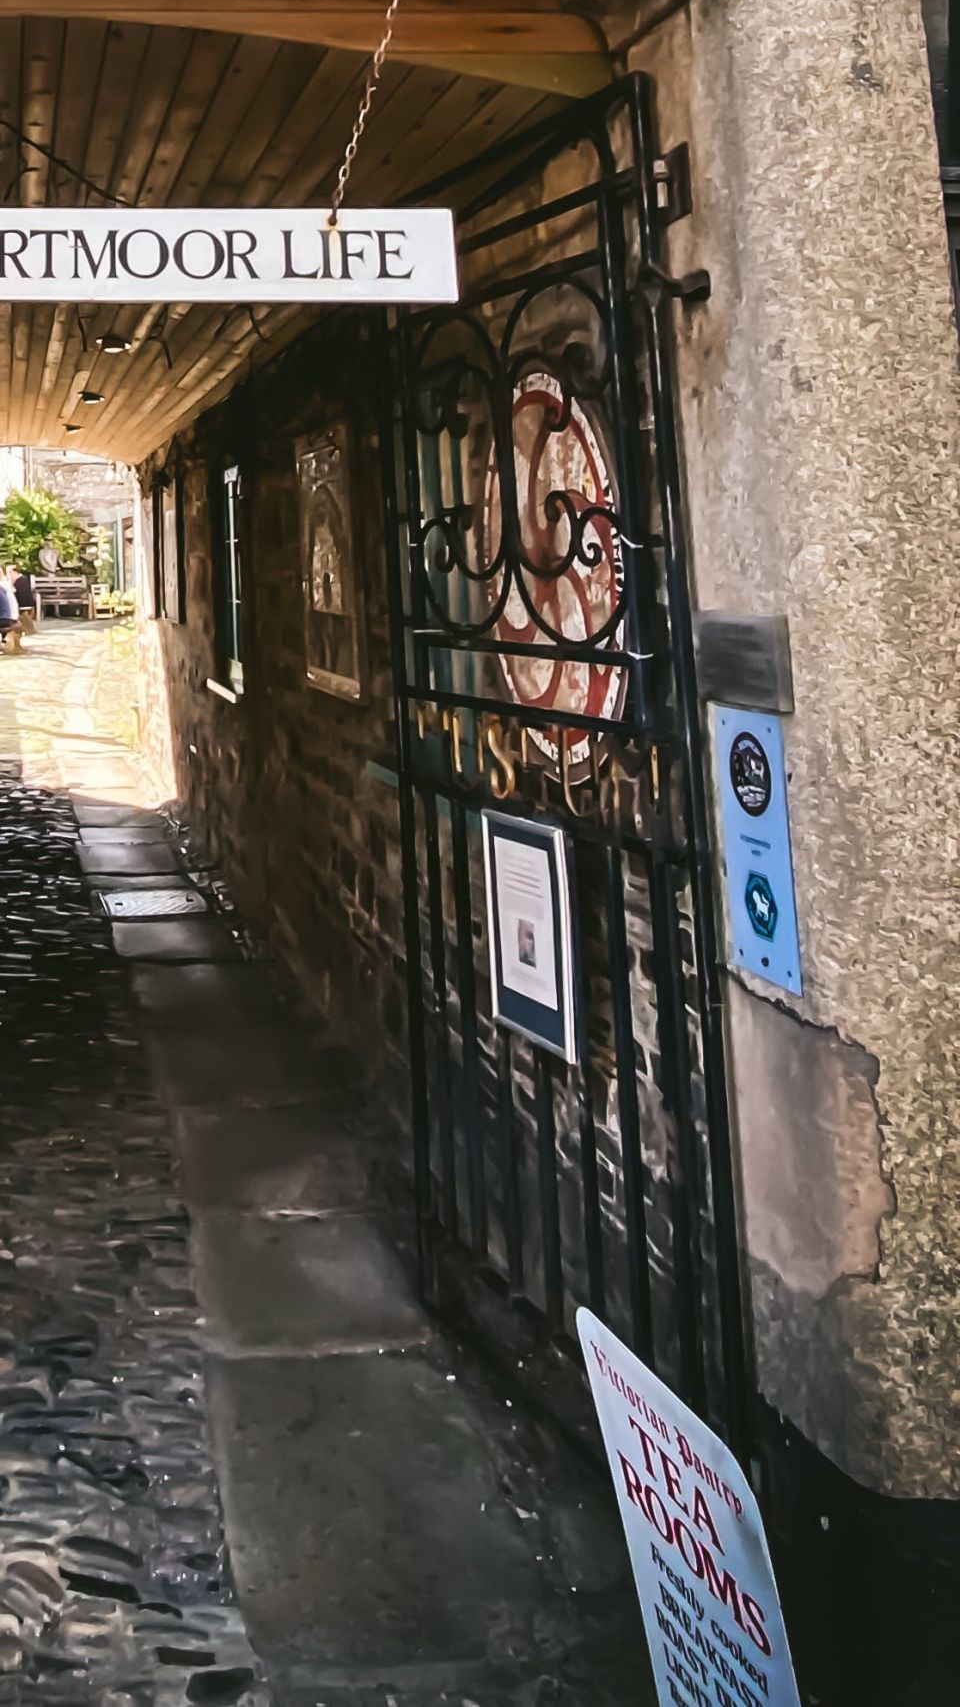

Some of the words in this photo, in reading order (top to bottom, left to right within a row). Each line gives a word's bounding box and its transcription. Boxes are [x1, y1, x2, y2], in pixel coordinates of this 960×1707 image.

[281, 227, 413, 280] LIFE
[590, 1340, 672, 1444] Victorian
[673, 1425, 744, 1523] Pantry
[627, 1414, 726, 1558] TEA
[615, 1448, 773, 1658] ROOMS
[650, 1540, 705, 1622] Freshly
[709, 1618, 769, 1698] cooked
[654, 1602, 709, 1687] ROAST
